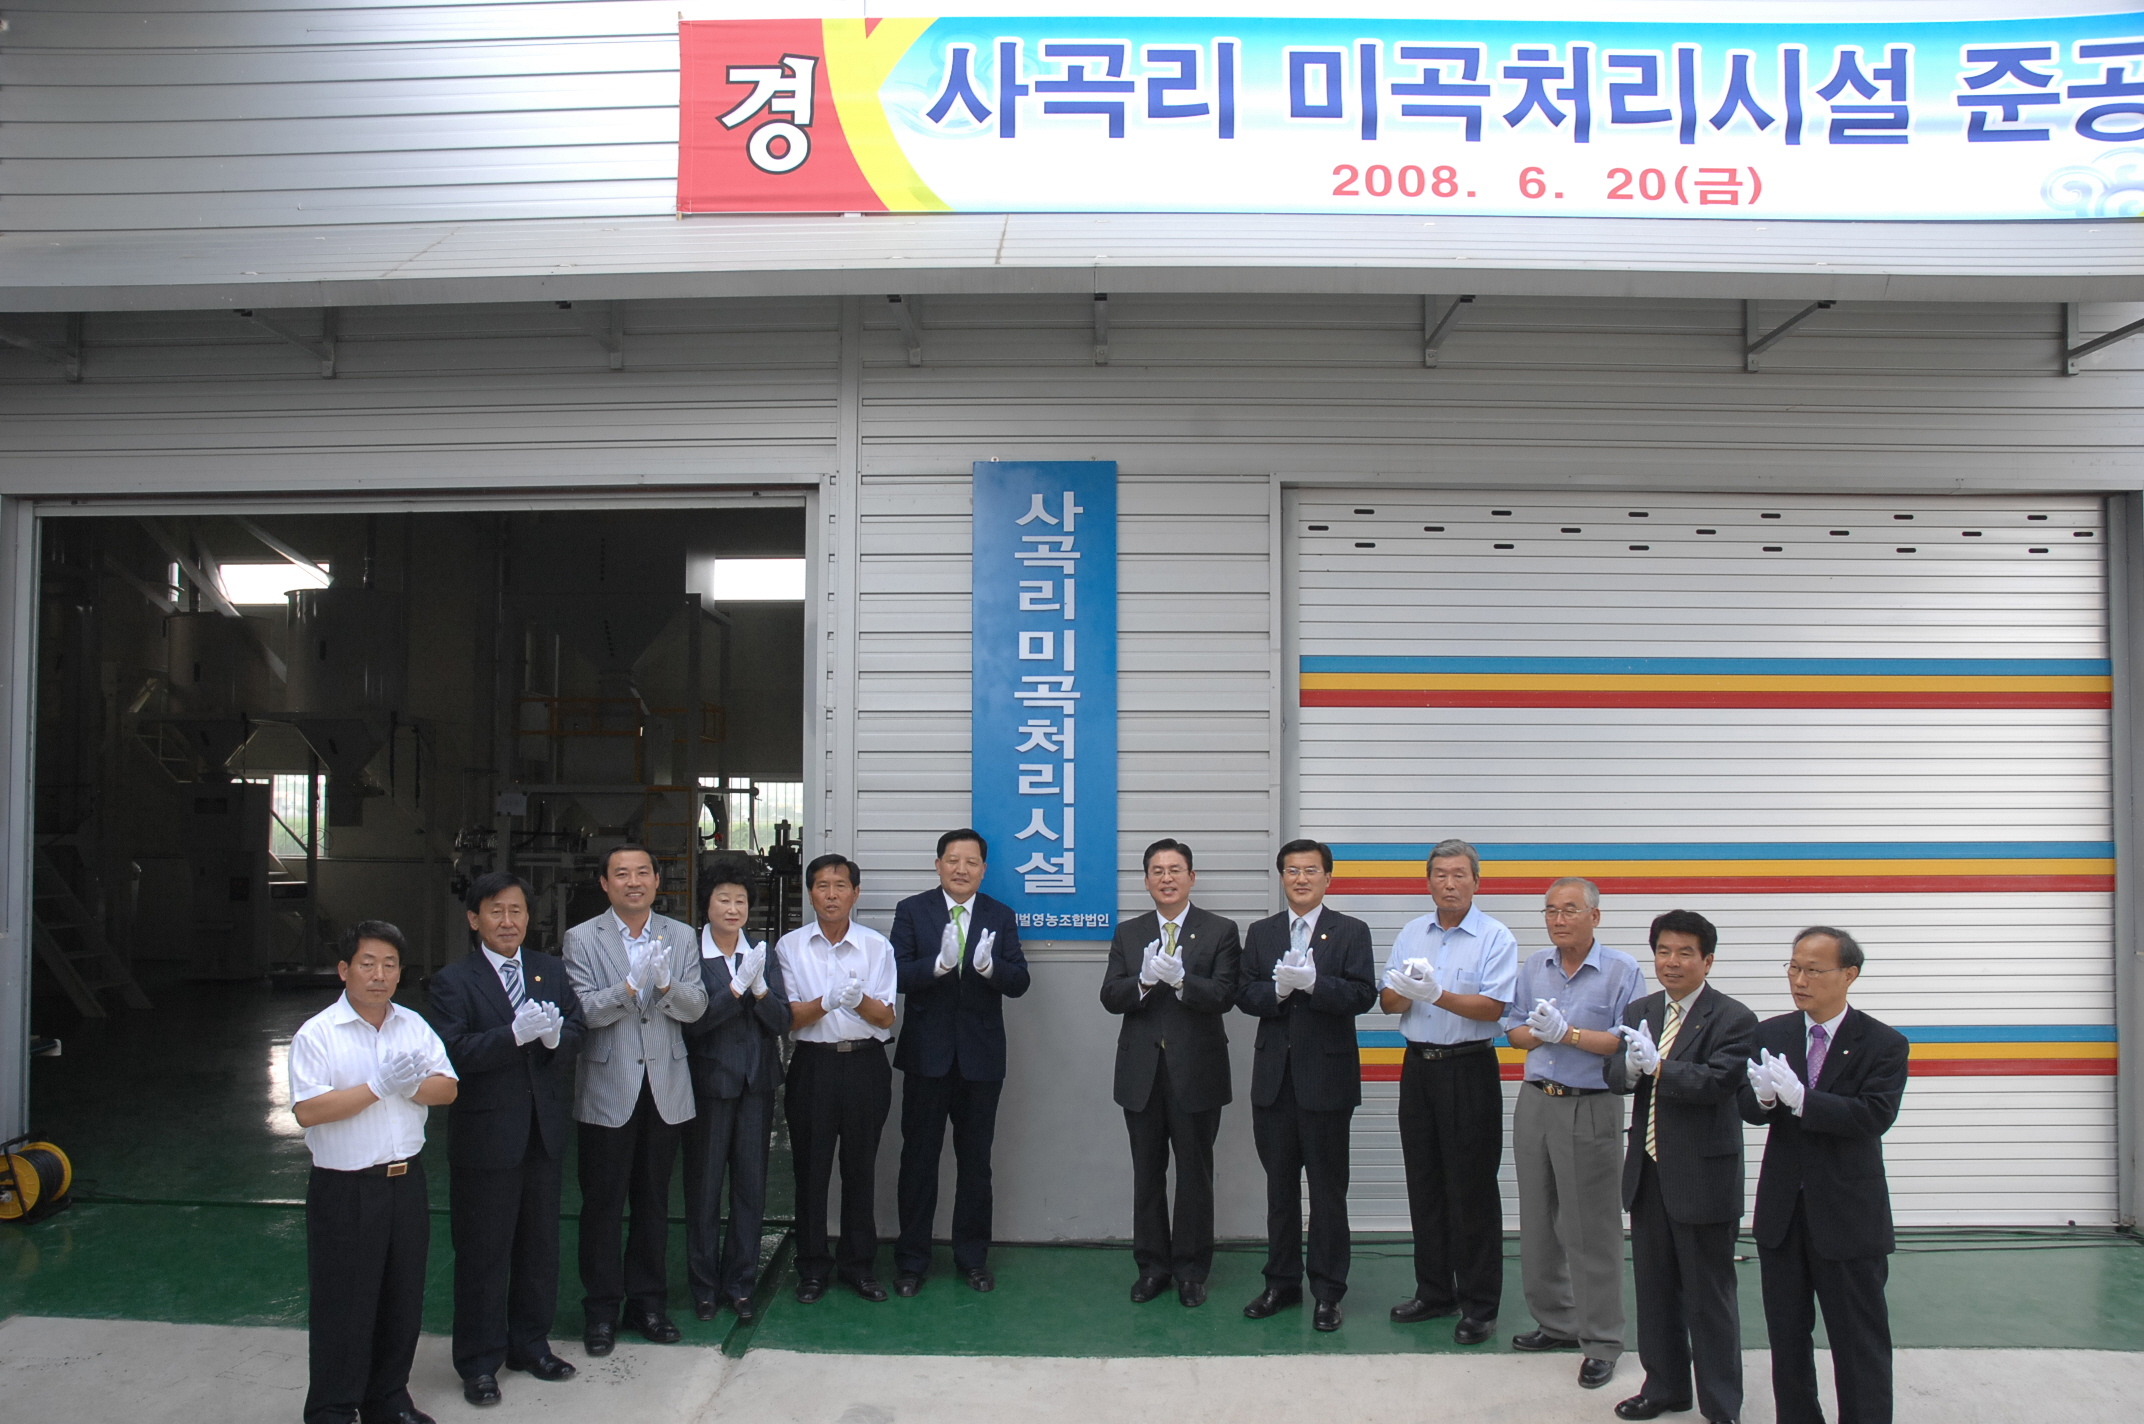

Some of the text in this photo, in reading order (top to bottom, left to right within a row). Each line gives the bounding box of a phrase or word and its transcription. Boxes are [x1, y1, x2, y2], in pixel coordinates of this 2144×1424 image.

[716, 53, 819, 175] 경
[925, 41, 2144, 145] 사곡리 미곡처리시설 준공
[1332, 163, 1764, 206] 2008. 6. 20(금)
[1014, 491, 1084, 894] 사곡리 미곡처리시설
[1015, 913, 1109, 927] 벌영농조합법인
